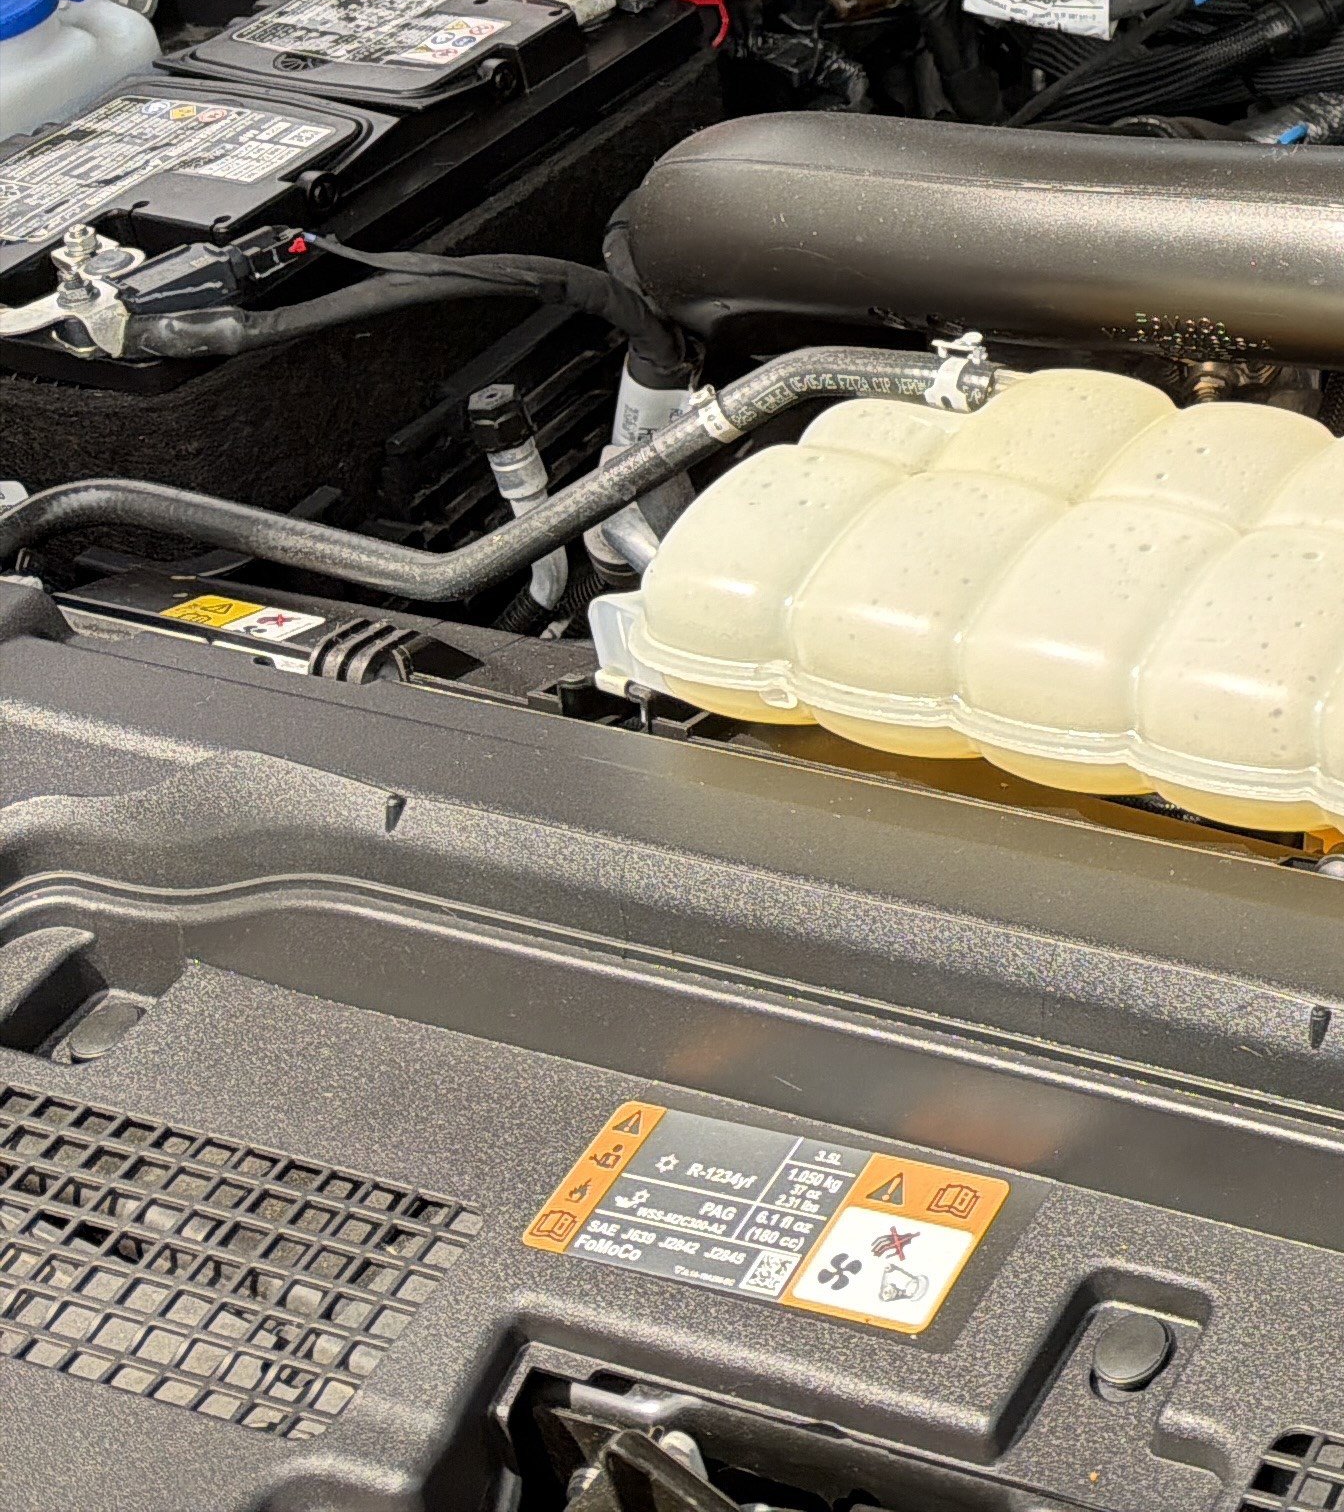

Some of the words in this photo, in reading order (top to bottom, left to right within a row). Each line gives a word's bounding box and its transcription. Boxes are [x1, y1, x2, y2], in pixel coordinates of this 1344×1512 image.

[814, 1150, 843, 1166] 3.5L
[686, 1162, 758, 1190] R-1234yf
[787, 1168, 824, 1186] 1.050
[823, 1175, 844, 1194] kg
[806, 1188, 823, 1201] oz
[699, 1201, 738, 1221] PAG
[755, 1210, 781, 1227] 6.1
[780, 1215, 794, 1230] fl
[793, 1221, 815, 1235] oz
[573, 1233, 642, 1261] FoMoCo
[587, 1220, 621, 1237] SAE
[621, 1227, 657, 1245] J639
[658, 1236, 701, 1255] J2842
[703, 1246, 747, 1265] J2845
[744, 1226, 781, 1245] (180
[779, 1235, 806, 1252] cc)
